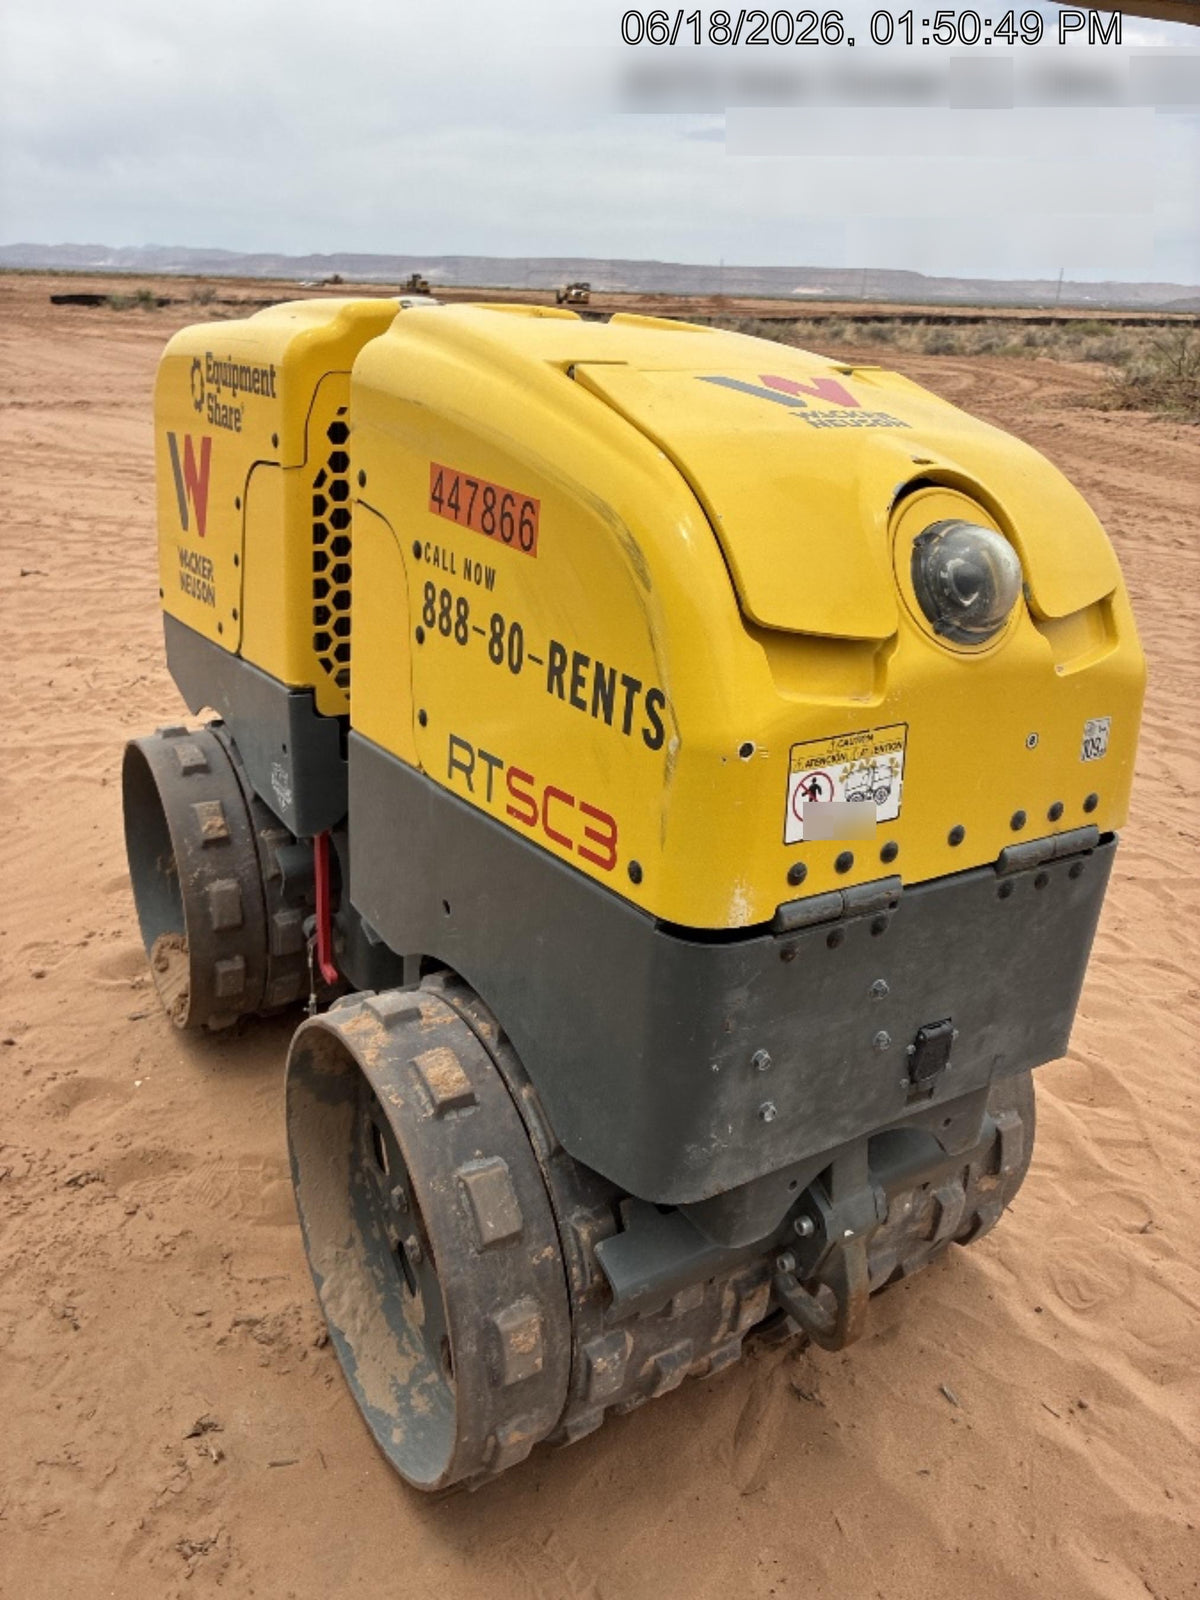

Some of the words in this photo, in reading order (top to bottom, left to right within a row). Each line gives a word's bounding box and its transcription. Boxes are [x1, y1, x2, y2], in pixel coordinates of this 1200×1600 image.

[205, 351, 277, 399] Equipment
[207, 394, 243, 433] Share
[430, 469, 537, 553] 447866
[177, 545, 214, 582] WACKER
[424, 541, 457, 576] CALL
[463, 557, 497, 592] NOW
[179, 570, 216, 608] NEUSON
[422, 580, 667, 751] 888-80-RENTS
